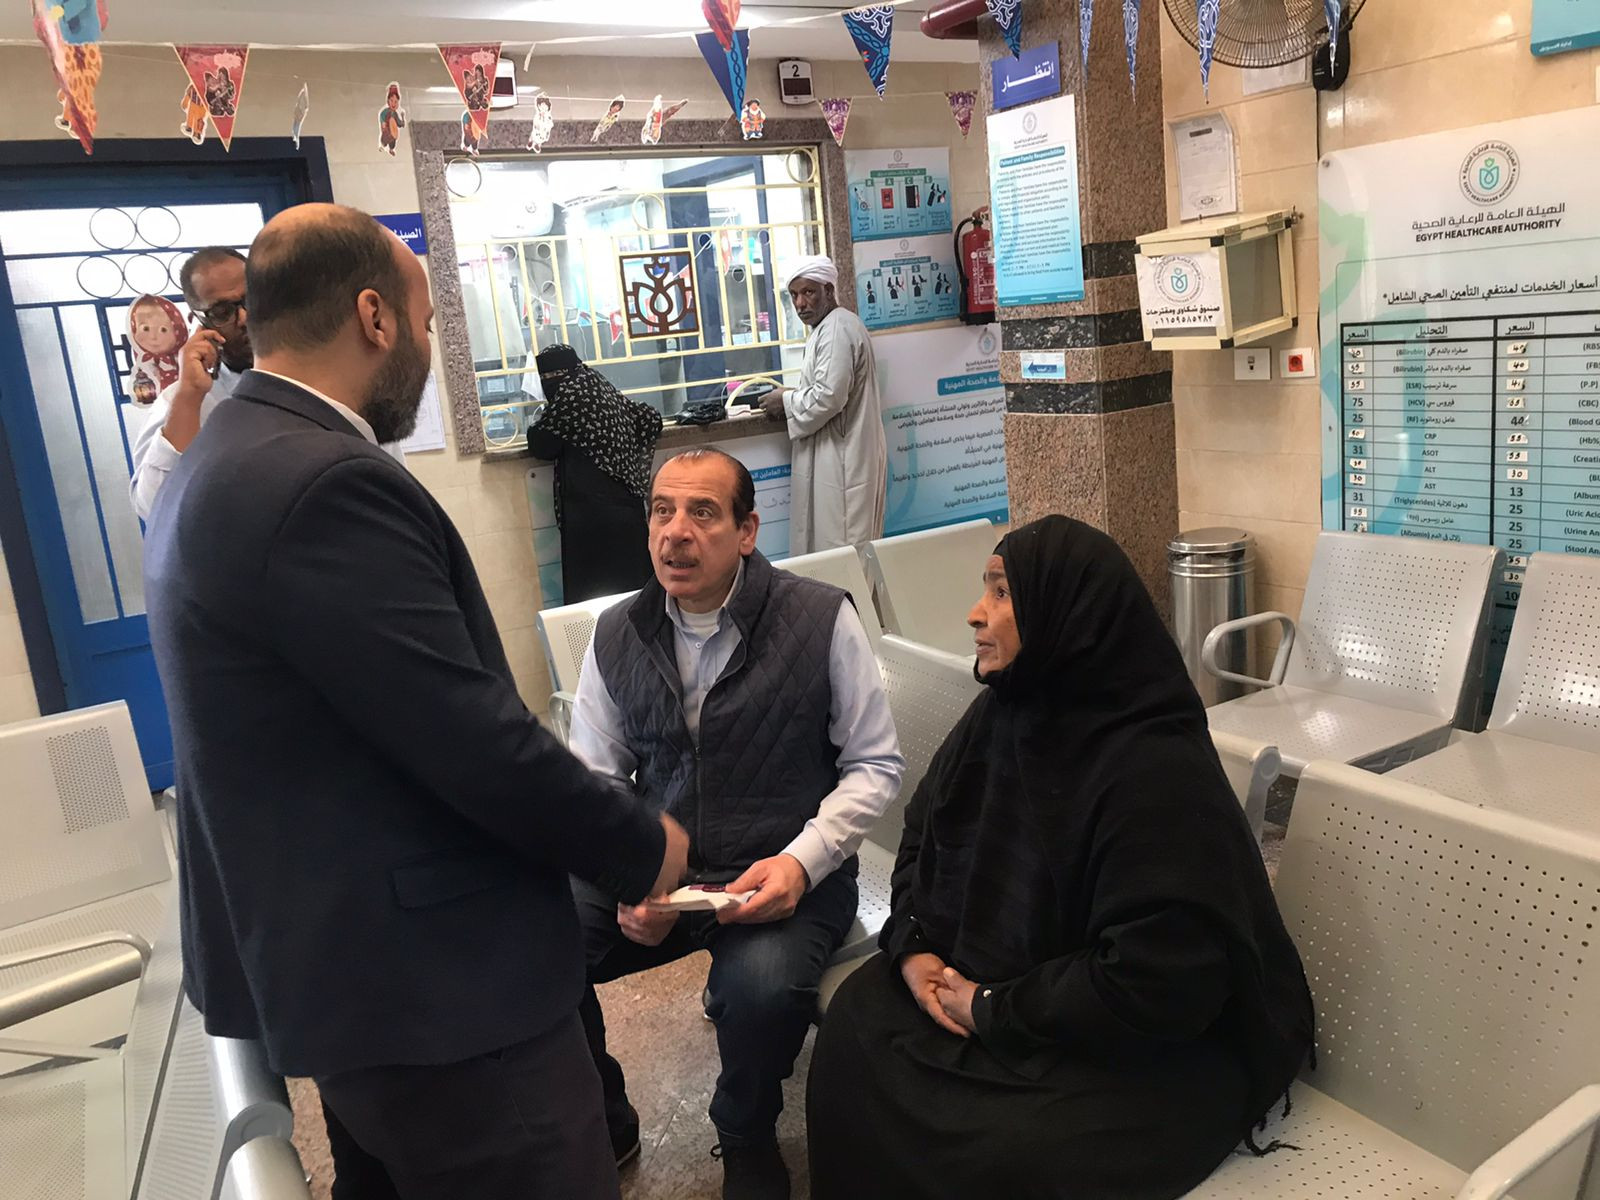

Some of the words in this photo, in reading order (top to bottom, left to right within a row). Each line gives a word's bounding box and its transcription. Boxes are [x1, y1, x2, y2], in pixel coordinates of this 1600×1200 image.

[792, 64, 800, 77] 2
[1487, 208, 1523, 221] العامة
[1526, 203, 1566, 218] الهيئة
[1412, 217, 1446, 232] الصحية
[1448, 212, 1483, 227] للرعاية
[1416, 231, 1443, 242] EGYPT
[1445, 224, 1503, 239] HEALTHCARE
[1504, 219, 1561, 233] AUTHORITY
[1521, 280, 1566, 292] الخدمات
[1568, 275, 1598, 293] أسعار
[1419, 288, 1448, 304] الصحي
[1450, 284, 1479, 300] التأمين
[1482, 284, 1518, 300] لمنتفعي
[1146, 306, 1176, 316] ومقترحات
[1177, 305, 1198, 315] شكاوى
[1199, 304, 1220, 314] صندوق
[1416, 325, 1448, 338] التحليل
[1505, 321, 1534, 335] السعر
[1346, 329, 1369, 341] السعر
[1580, 380, 1598, 388] (P.P)
[1352, 397, 1364, 407] 75
[1578, 400, 1599, 408] (CBC)
[1352, 413, 1364, 423] 25
[1568, 418, 1594, 426] (Blood
[1580, 437, 1600, 446] (Hb%
[1352, 445, 1364, 455] 31
[1352, 492, 1364, 502] 31
[1509, 486, 1524, 497] 13
[1508, 504, 1524, 515] 25
[1566, 510, 1583, 518] (Uric
[1508, 521, 1523, 532] 25
[1564, 527, 1588, 536] (Urine
[1508, 538, 1522, 550] 25
[1564, 545, 1588, 554] (Stool
[1588, 546, 1600, 556] An
[1504, 590, 1518, 601] 10
